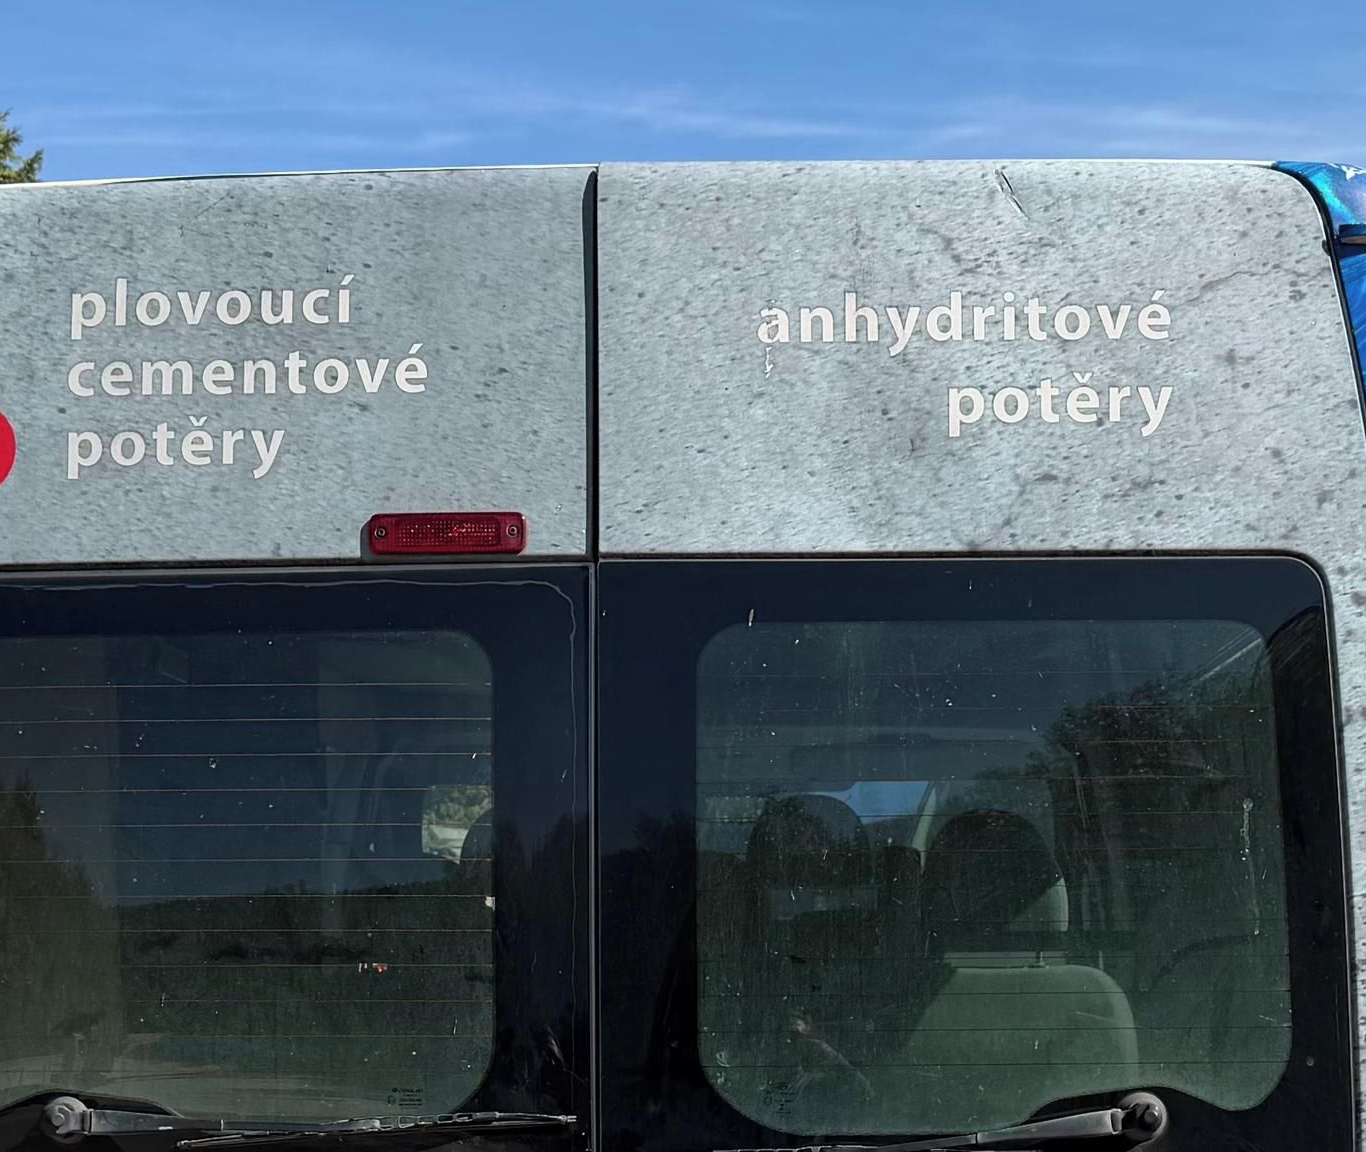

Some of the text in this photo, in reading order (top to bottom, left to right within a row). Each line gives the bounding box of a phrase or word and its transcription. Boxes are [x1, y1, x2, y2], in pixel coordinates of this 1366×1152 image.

[71, 273, 355, 341] plovoucí
[757, 290, 1172, 357] anhydritové
[67, 342, 429, 398] cementové
[948, 372, 1174, 438] potěry
[66, 415, 286, 480] potěry
